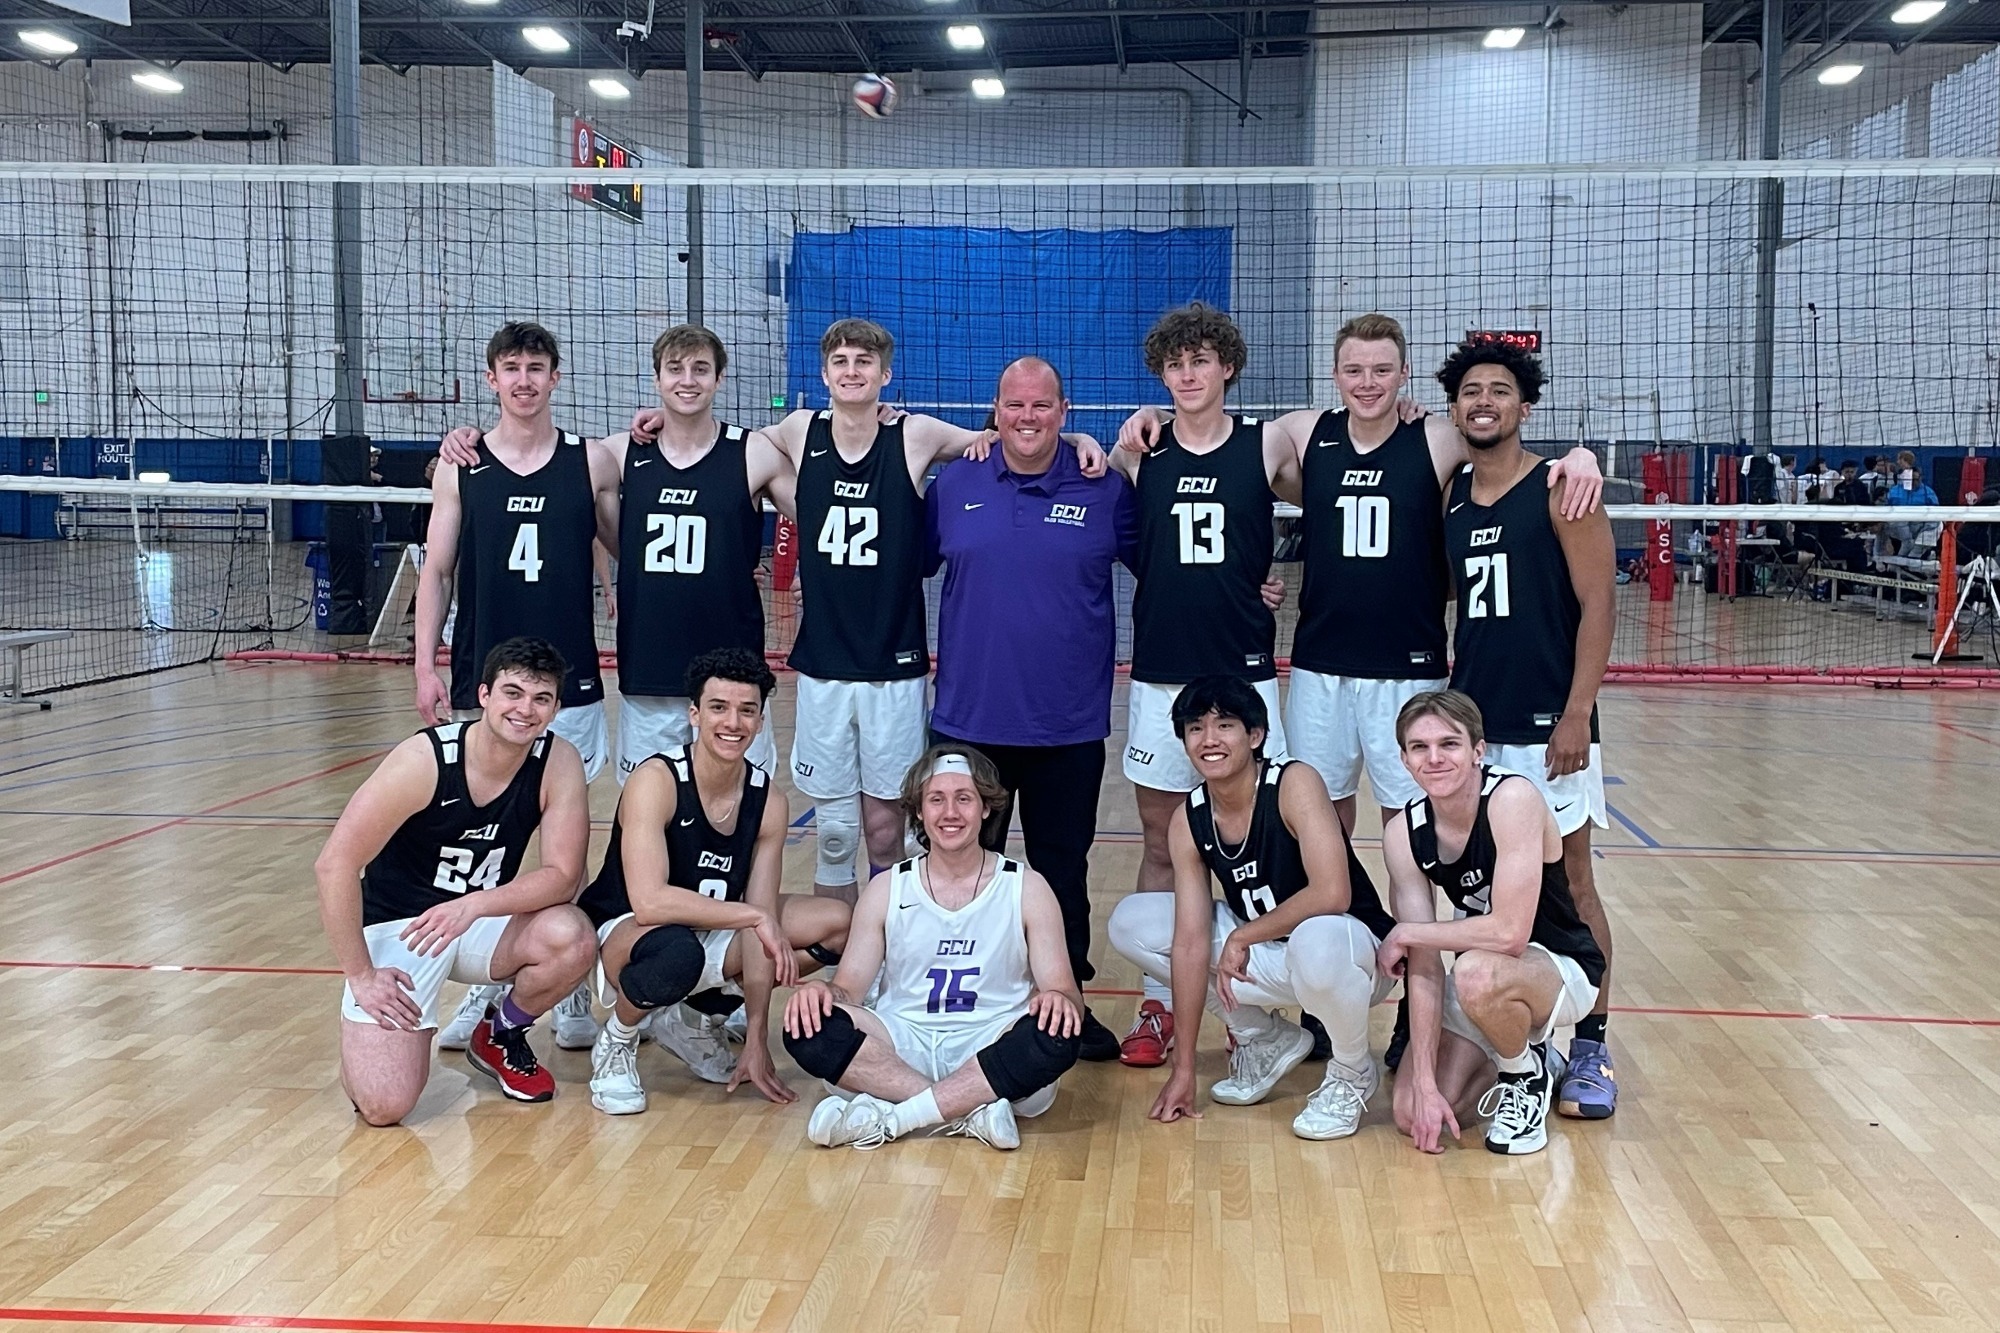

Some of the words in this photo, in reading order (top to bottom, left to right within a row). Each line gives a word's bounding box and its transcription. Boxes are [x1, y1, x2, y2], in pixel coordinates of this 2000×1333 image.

[97, 453, 131, 464] ROUTE
[103, 443, 125, 454] EXIT
[1177, 477, 1218, 494] GCU
[1343, 470, 1384, 487] GCU
[658, 488, 698, 505] GCU
[834, 480, 870, 499] GCU
[506, 496, 546, 513] GCU
[1050, 504, 1088, 521] GCU
[817, 505, 879, 566] 42
[1170, 502, 1225, 564] 13
[1334, 495, 1390, 558] 10
[1469, 526, 1503, 547] GCU
[508, 523, 544, 582] 4
[644, 513, 707, 574] 20
[1464, 553, 1510, 618] 21
[433, 846, 506, 894] 24
[697, 850, 733, 873] GCU
[936, 939, 977, 956] GCU
